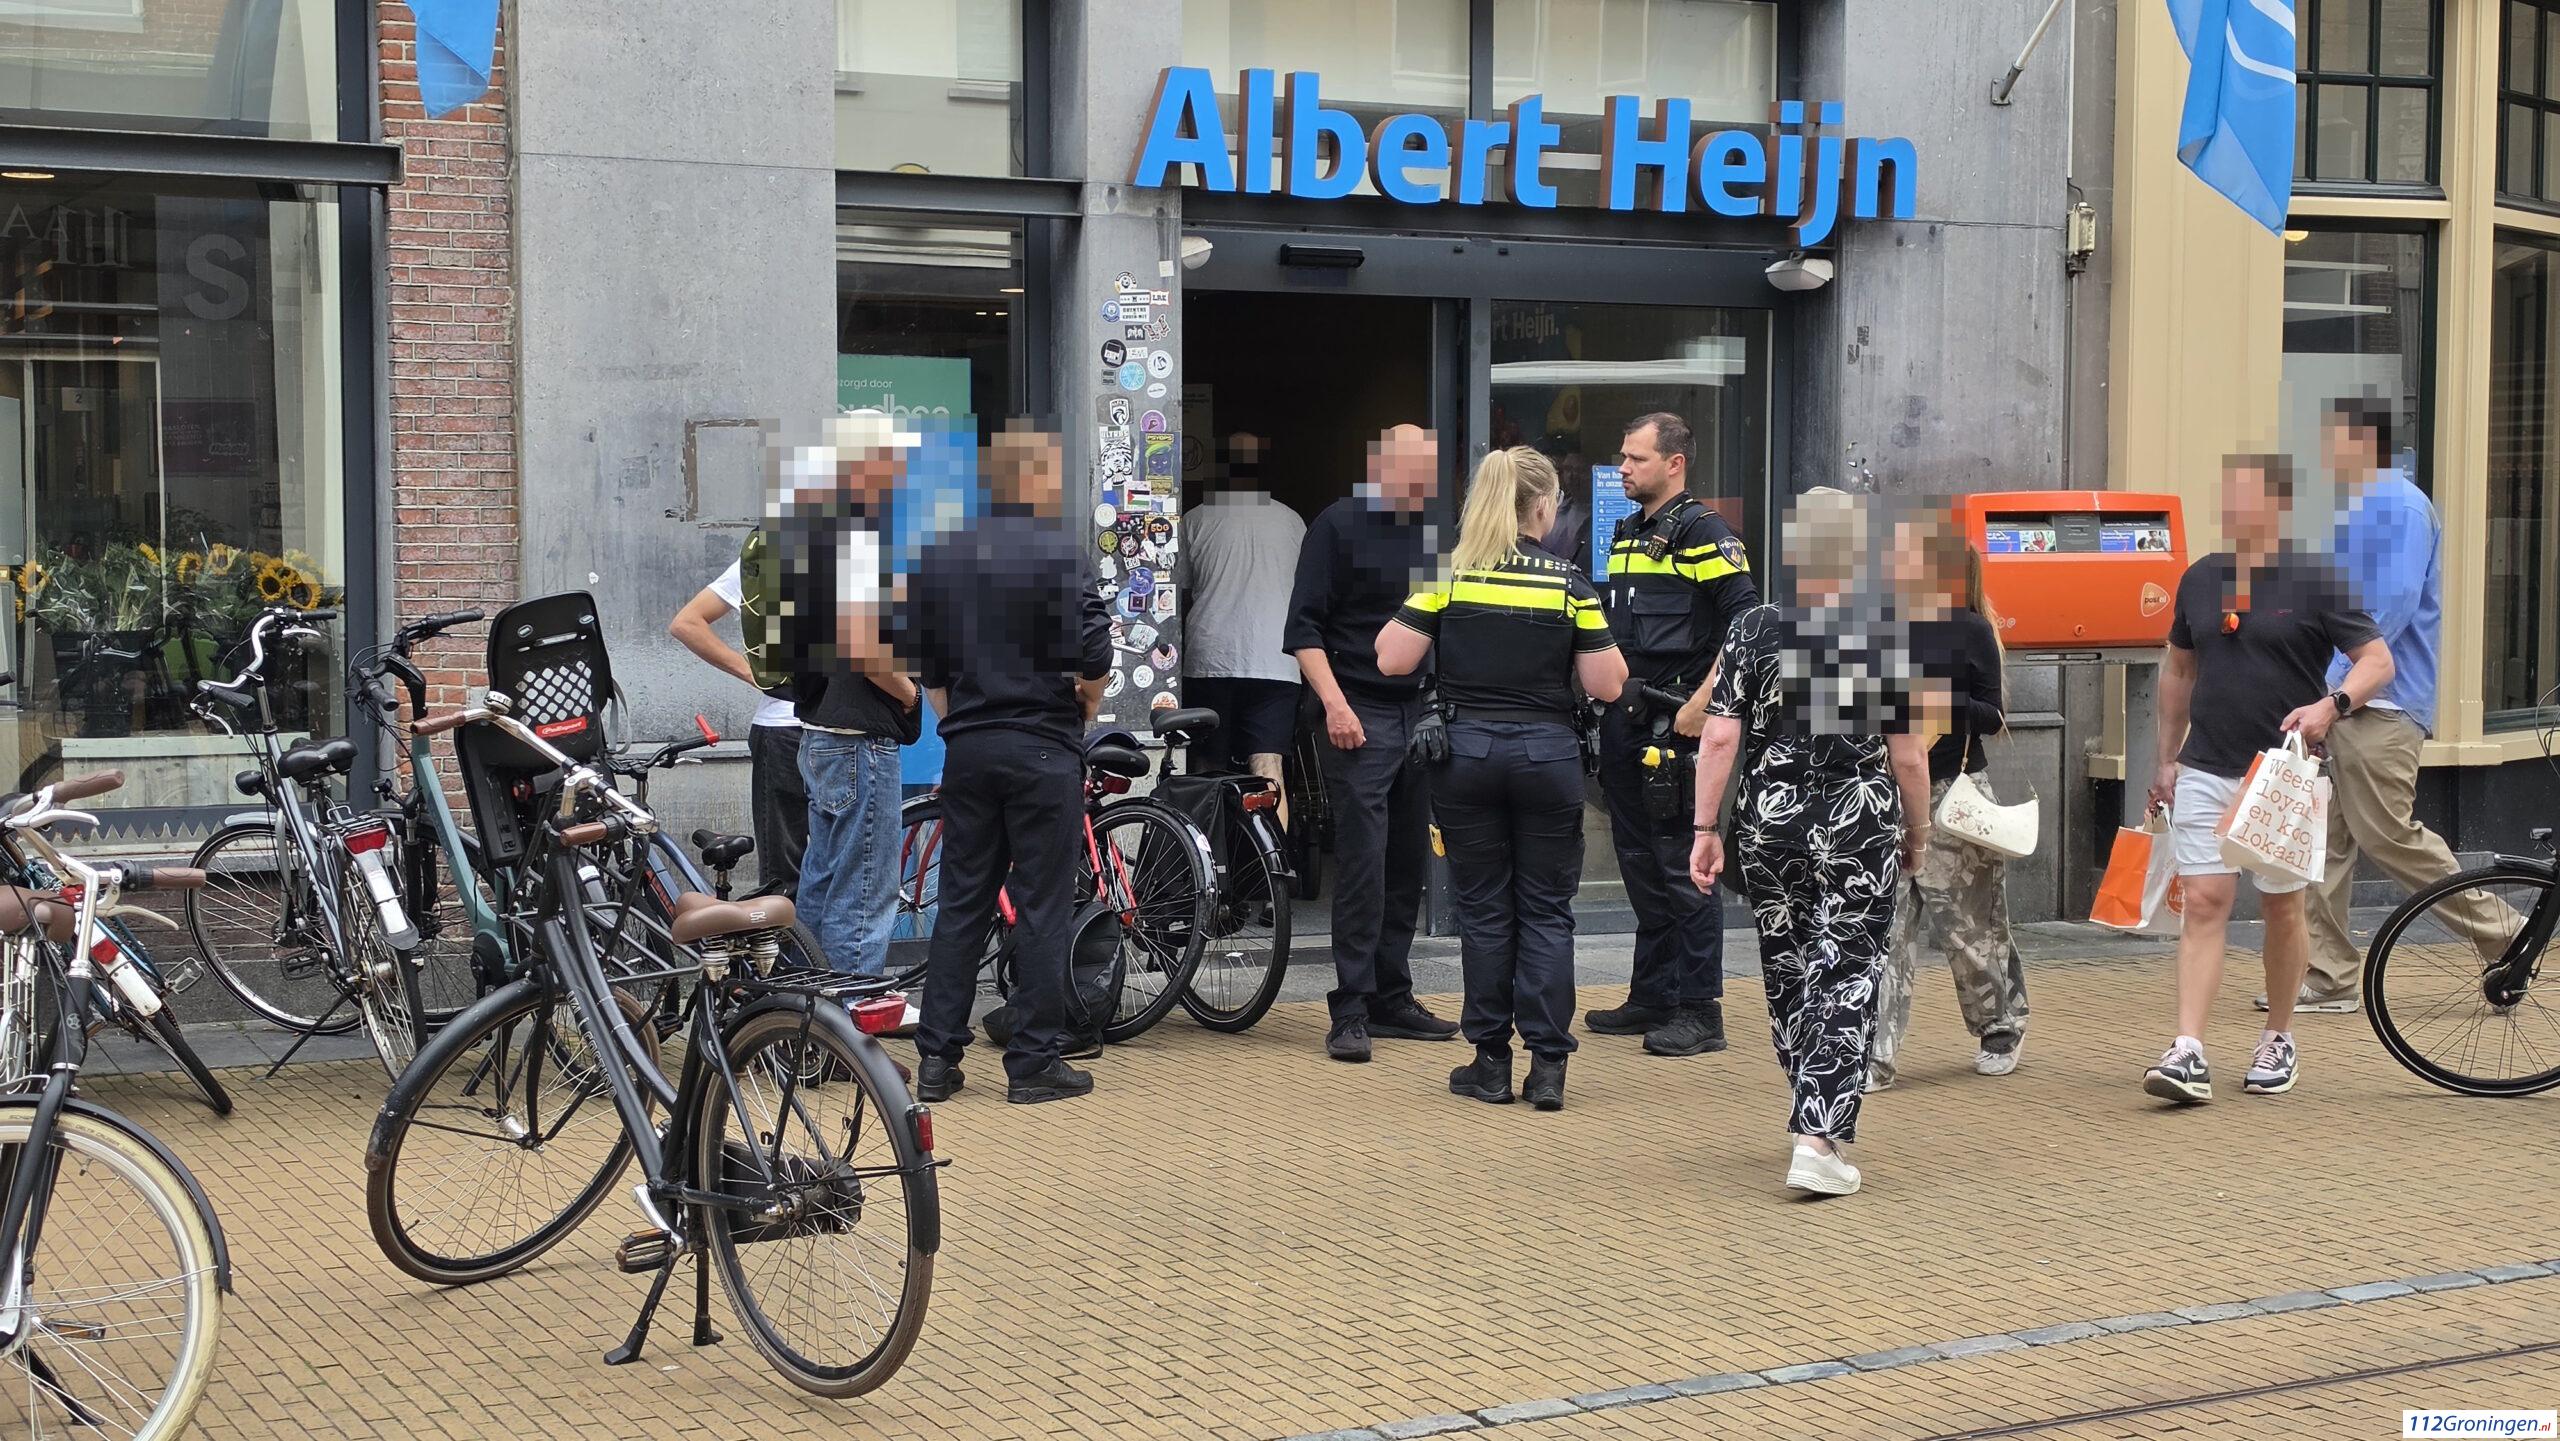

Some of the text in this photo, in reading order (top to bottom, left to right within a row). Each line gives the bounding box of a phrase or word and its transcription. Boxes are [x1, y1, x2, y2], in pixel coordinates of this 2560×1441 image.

[1133, 66, 1919, 247] Albert Heijn
[839, 378, 893, 390] zorgd door
[1597, 471, 1611, 479] Van
[2269, 758, 2315, 794] Wees
[2249, 805, 2273, 827] en
[2256, 778, 2313, 824] loya
[2237, 821, 2312, 872] lokaal!
